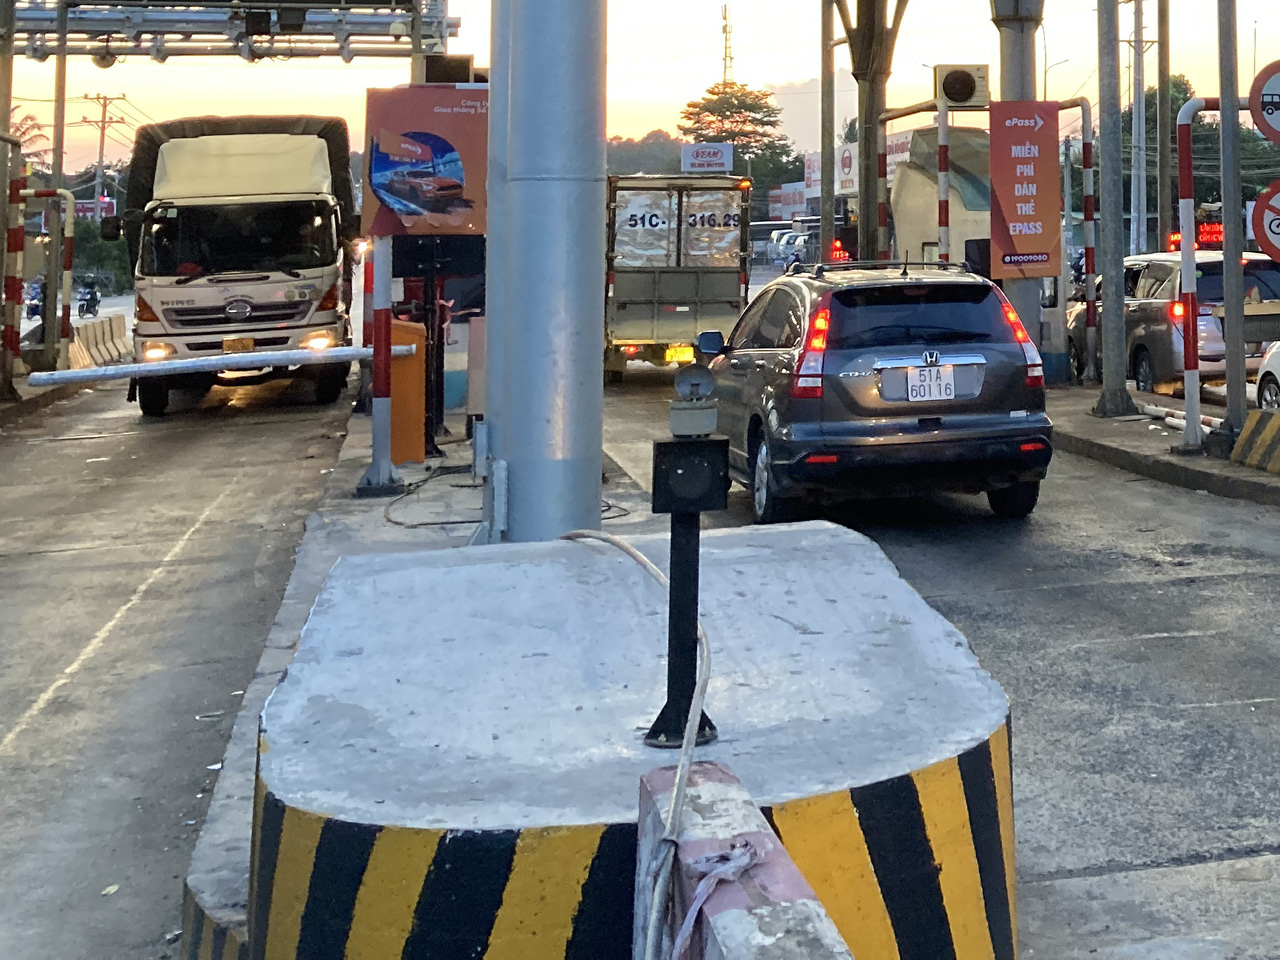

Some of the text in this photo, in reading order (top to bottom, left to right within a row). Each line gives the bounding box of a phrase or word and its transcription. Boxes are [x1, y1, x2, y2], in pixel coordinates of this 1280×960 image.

[1005, 117, 1035, 127] ePass
[1011, 142, 1039, 158] MIỄN
[1016, 162, 1034, 177] PHÍ
[1015, 181, 1037, 196] DÁN
[1016, 199, 1035, 215] THẺ
[688, 213, 741, 228] 316.29
[1009, 222, 1043, 235] EPASS
[919, 368, 942, 383] 51A
